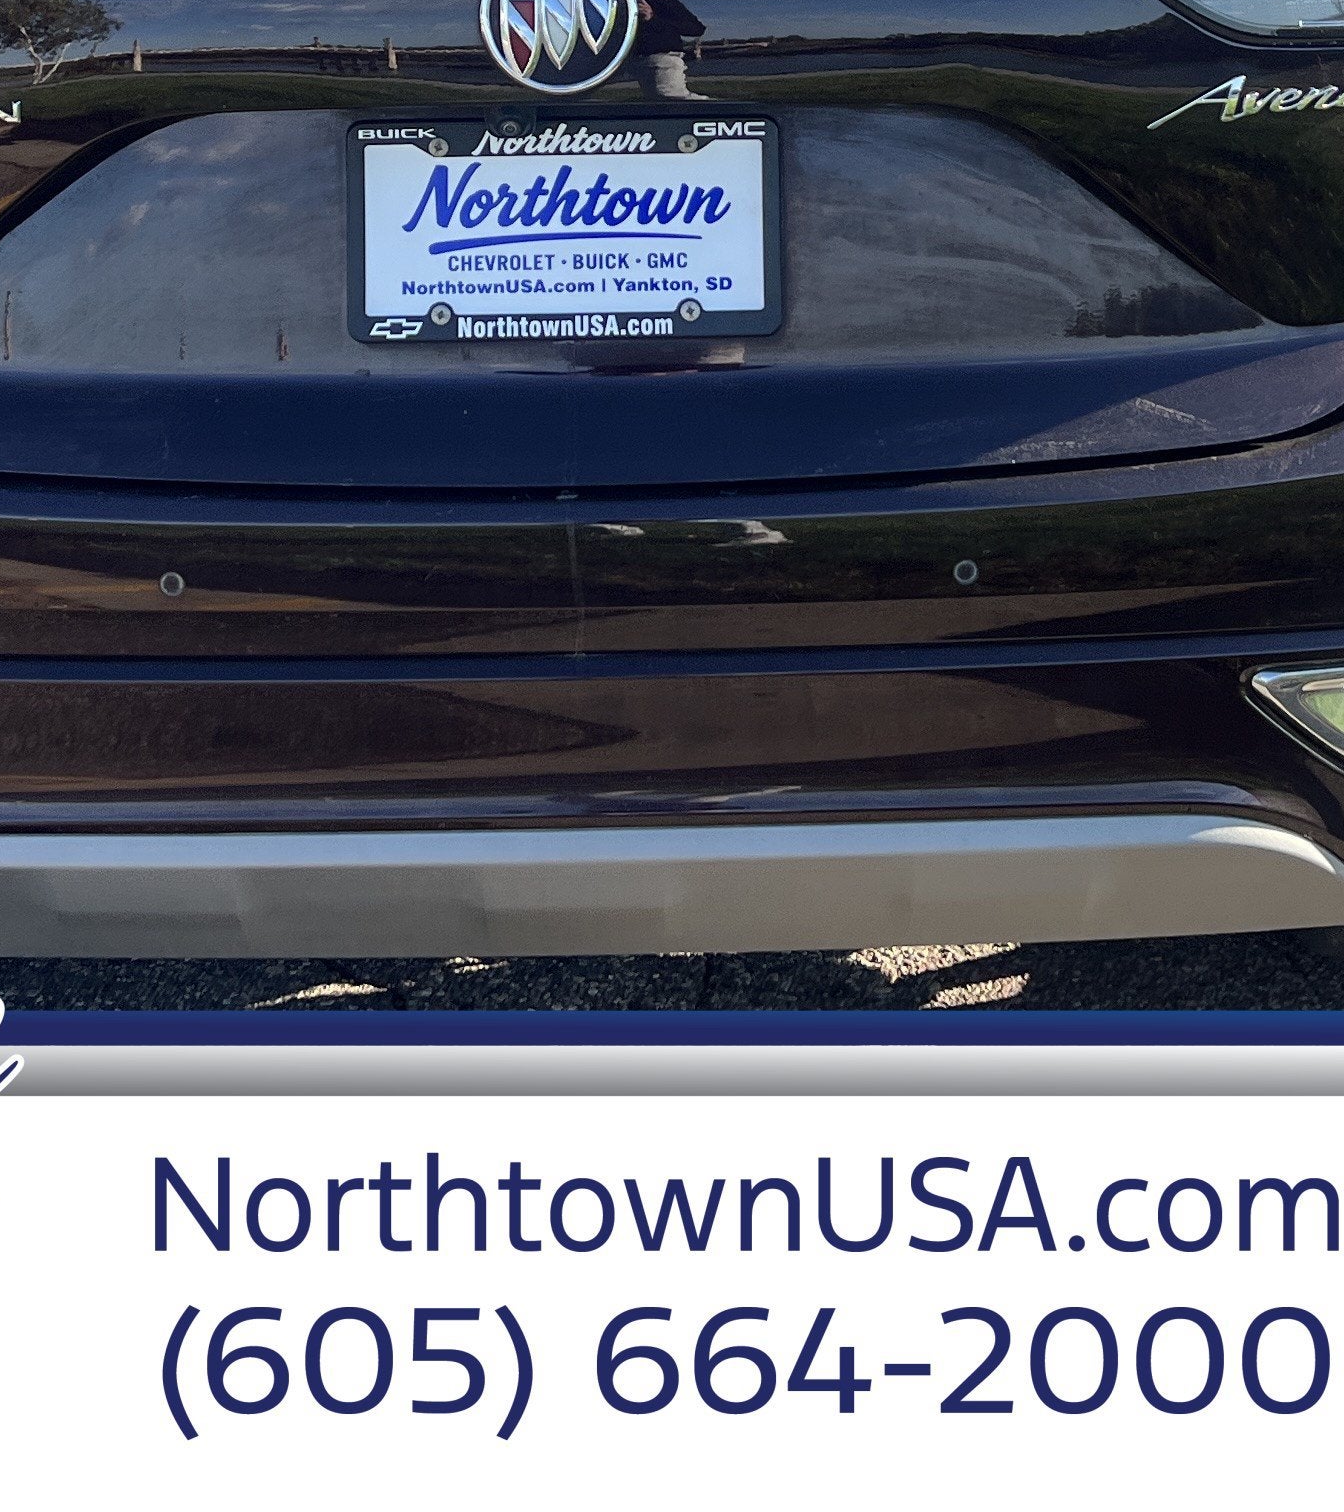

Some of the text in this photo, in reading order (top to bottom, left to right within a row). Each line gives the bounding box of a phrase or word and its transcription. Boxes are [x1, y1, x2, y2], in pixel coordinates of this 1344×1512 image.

[357, 127, 437, 139] BUICK
[471, 122, 657, 156] Northtown
[692, 121, 766, 137] GMC
[401, 161, 732, 233] Northtown
[448, 251, 688, 271] CHEVROLET BUICK GMC
[401, 276, 733, 295] NorthtownUSA.com Yankton, SD
[457, 314, 674, 339] NorthtownUSA.com
